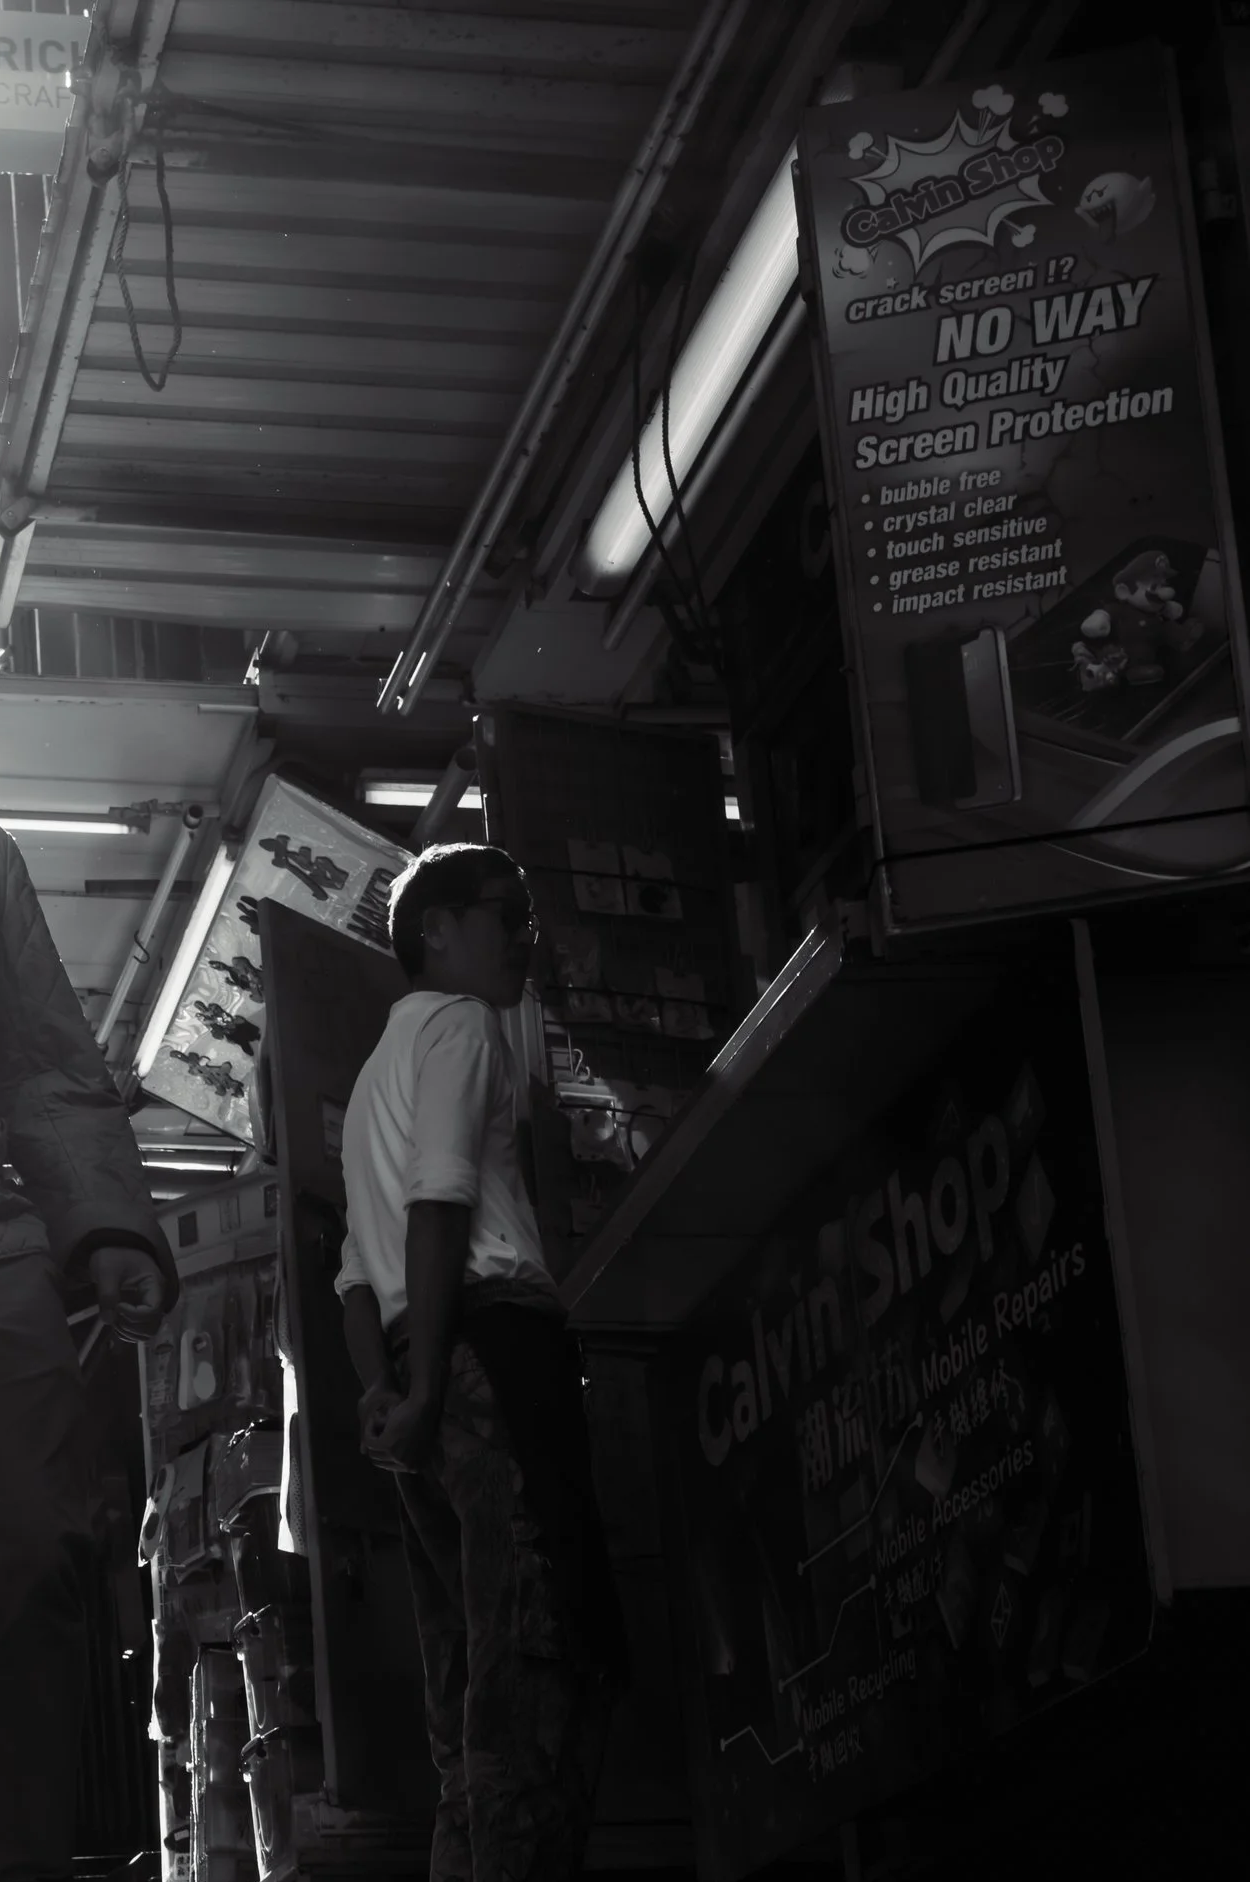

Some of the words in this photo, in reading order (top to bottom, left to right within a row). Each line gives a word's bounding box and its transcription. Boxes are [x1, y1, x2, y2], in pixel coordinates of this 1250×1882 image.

[846, 179, 964, 244] Calvin
[963, 135, 1065, 196] Shop
[848, 286, 928, 321] crack
[938, 269, 1034, 303] screen
[1047, 256, 1075, 284] !?
[936, 306, 1013, 363] NO
[1032, 276, 1154, 345] WAY
[850, 379, 930, 423] High
[943, 355, 1066, 409] Quality
[855, 424, 977, 469] Screen
[990, 386, 1174, 447] Protection
[880, 477, 950, 505] bubble
[959, 469, 1001, 491] free
[883, 502, 956, 533] crystal
[963, 493, 1018, 518] clear
[886, 532, 945, 559] touch
[952, 516, 1047, 547] sensitive
[889, 560, 959, 591] grease
[968, 538, 1063, 573] resistant
[892, 583, 965, 614] impact
[972, 565, 1067, 600] resistant
[698, 1269, 847, 1467] Calvin
[853, 1115, 1010, 1328] Shop
[921, 1319, 989, 1400] Mobile
[993, 1241, 1087, 1337] Repairs
[876, 1512, 927, 1572] Mobile
[931, 1439, 1035, 1529] Accessories
[803, 1687, 847, 1736] Mobile
[848, 1646, 917, 1703] Recycling
